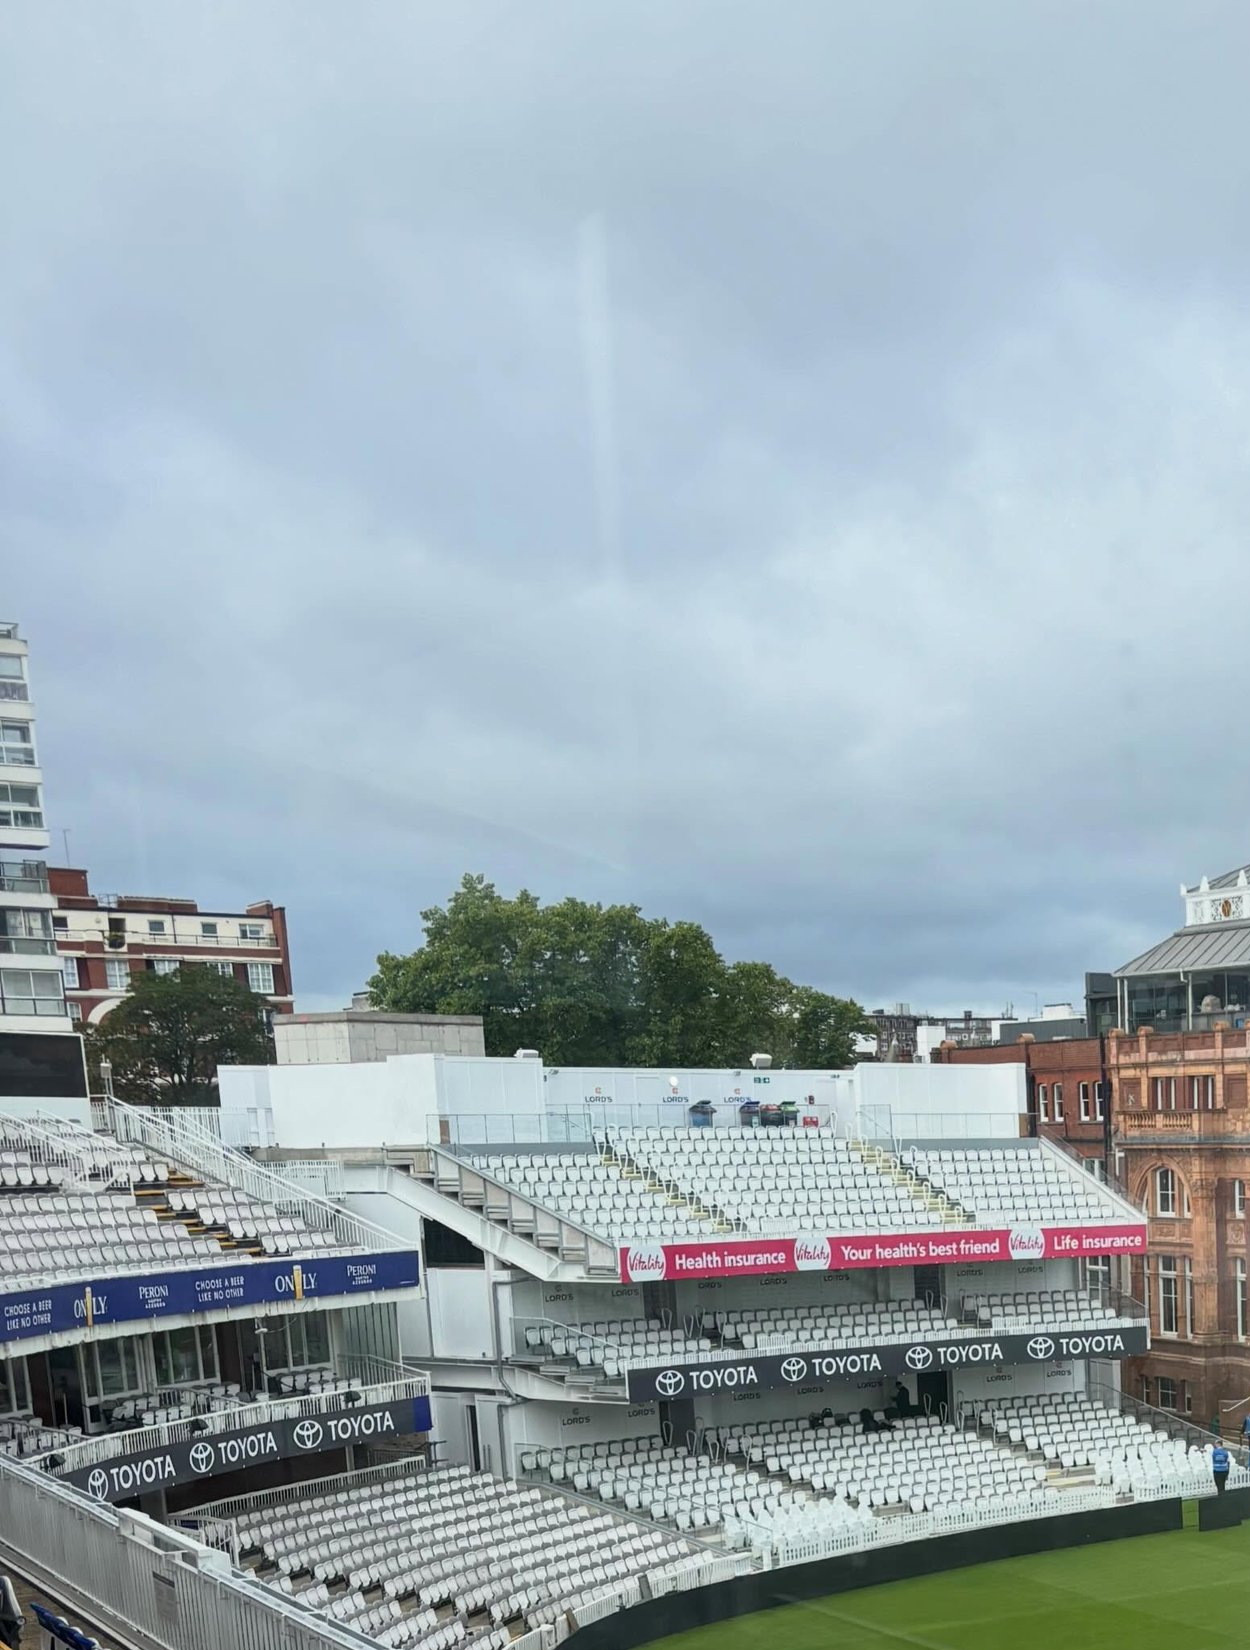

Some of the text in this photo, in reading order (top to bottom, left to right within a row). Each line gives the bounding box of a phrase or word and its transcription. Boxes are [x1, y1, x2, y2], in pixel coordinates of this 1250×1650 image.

[840, 1238, 1000, 1261] Your health's best friend
[1010, 1232, 1044, 1253] Vitality
[1054, 1234, 1142, 1250] Life insurance
[628, 1252, 665, 1273] Vitality
[675, 1251, 786, 1270] Health insurance
[796, 1242, 830, 1264] Vitality
[347, 1264, 376, 1277] PERONI
[139, 1285, 168, 1300] PERONI
[195, 1278, 222, 1291] CHOOSE
[230, 1276, 244, 1286] BEER
[198, 1288, 244, 1302] LIKE NO OTHER
[4, 1303, 30, 1318] CHOOSE
[7, 1313, 52, 1330] LIKE NO OTHER
[937, 1342, 1004, 1364] TOYOTA
[1060, 1334, 1124, 1355] TOYOTA
[812, 1354, 882, 1376] TOYOTA
[689, 1366, 758, 1390] TOYOTA
[328, 1410, 395, 1441] TOYOTA
[218, 1431, 278, 1464] TOYOTA
[110, 1454, 176, 1492] TOYOTA
